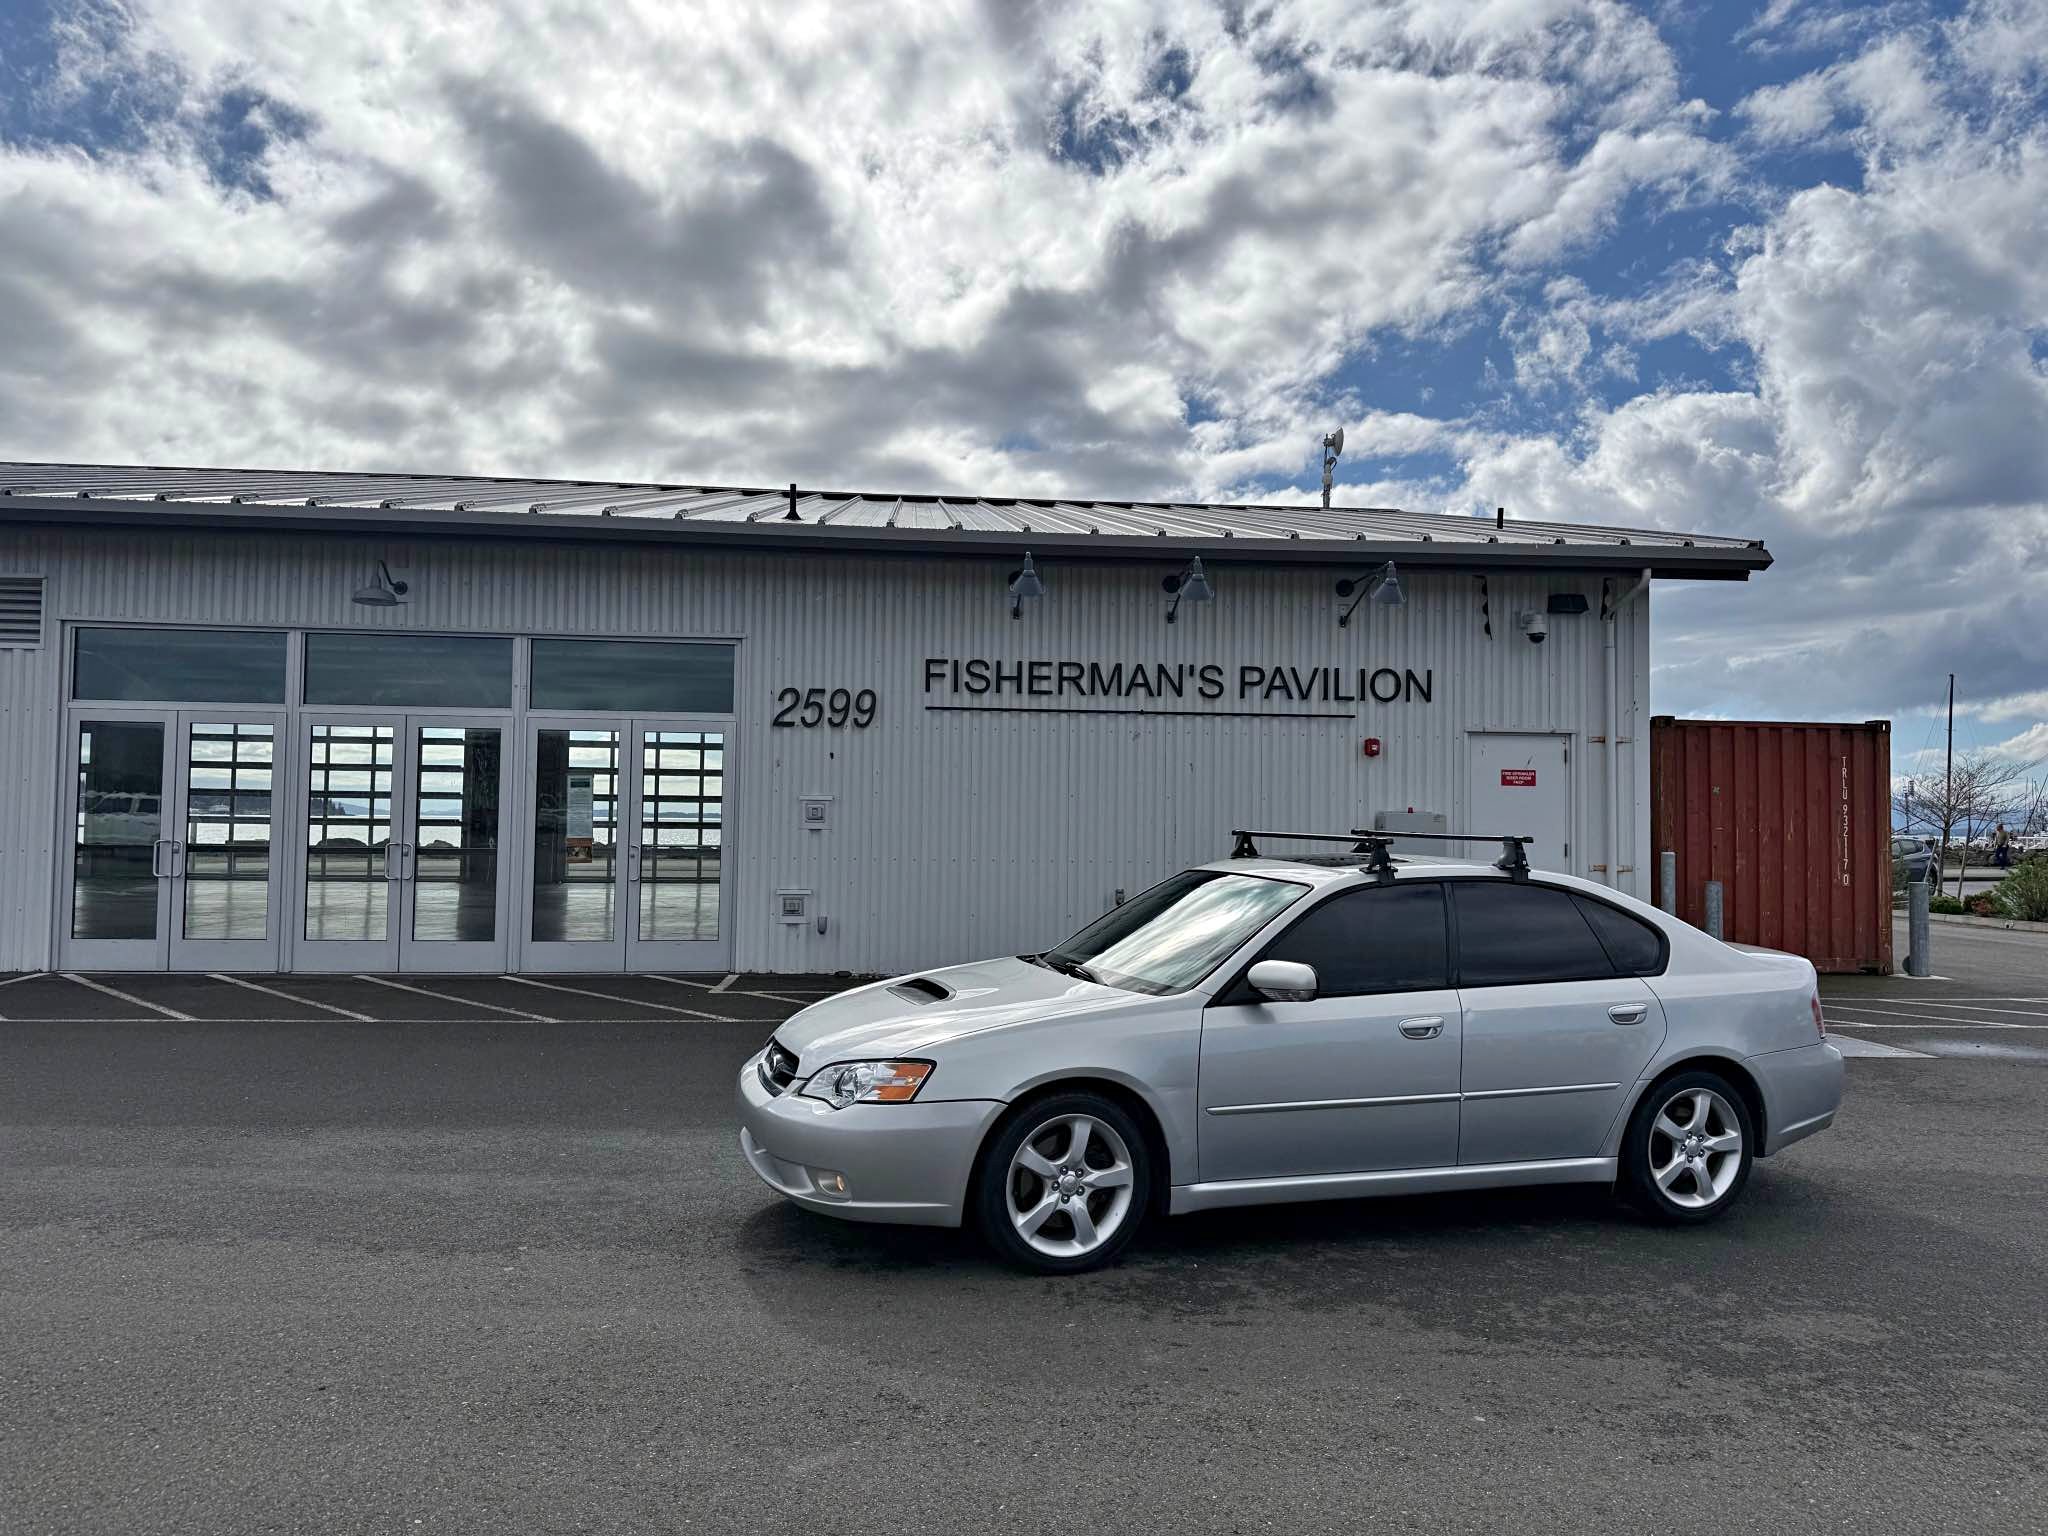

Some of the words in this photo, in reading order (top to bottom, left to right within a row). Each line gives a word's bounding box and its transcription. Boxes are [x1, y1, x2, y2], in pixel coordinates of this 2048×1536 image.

[924, 658, 1225, 699] FISHERMAN'S
[1239, 665, 1433, 703] PAVILION
[772, 687, 877, 728] 2599
